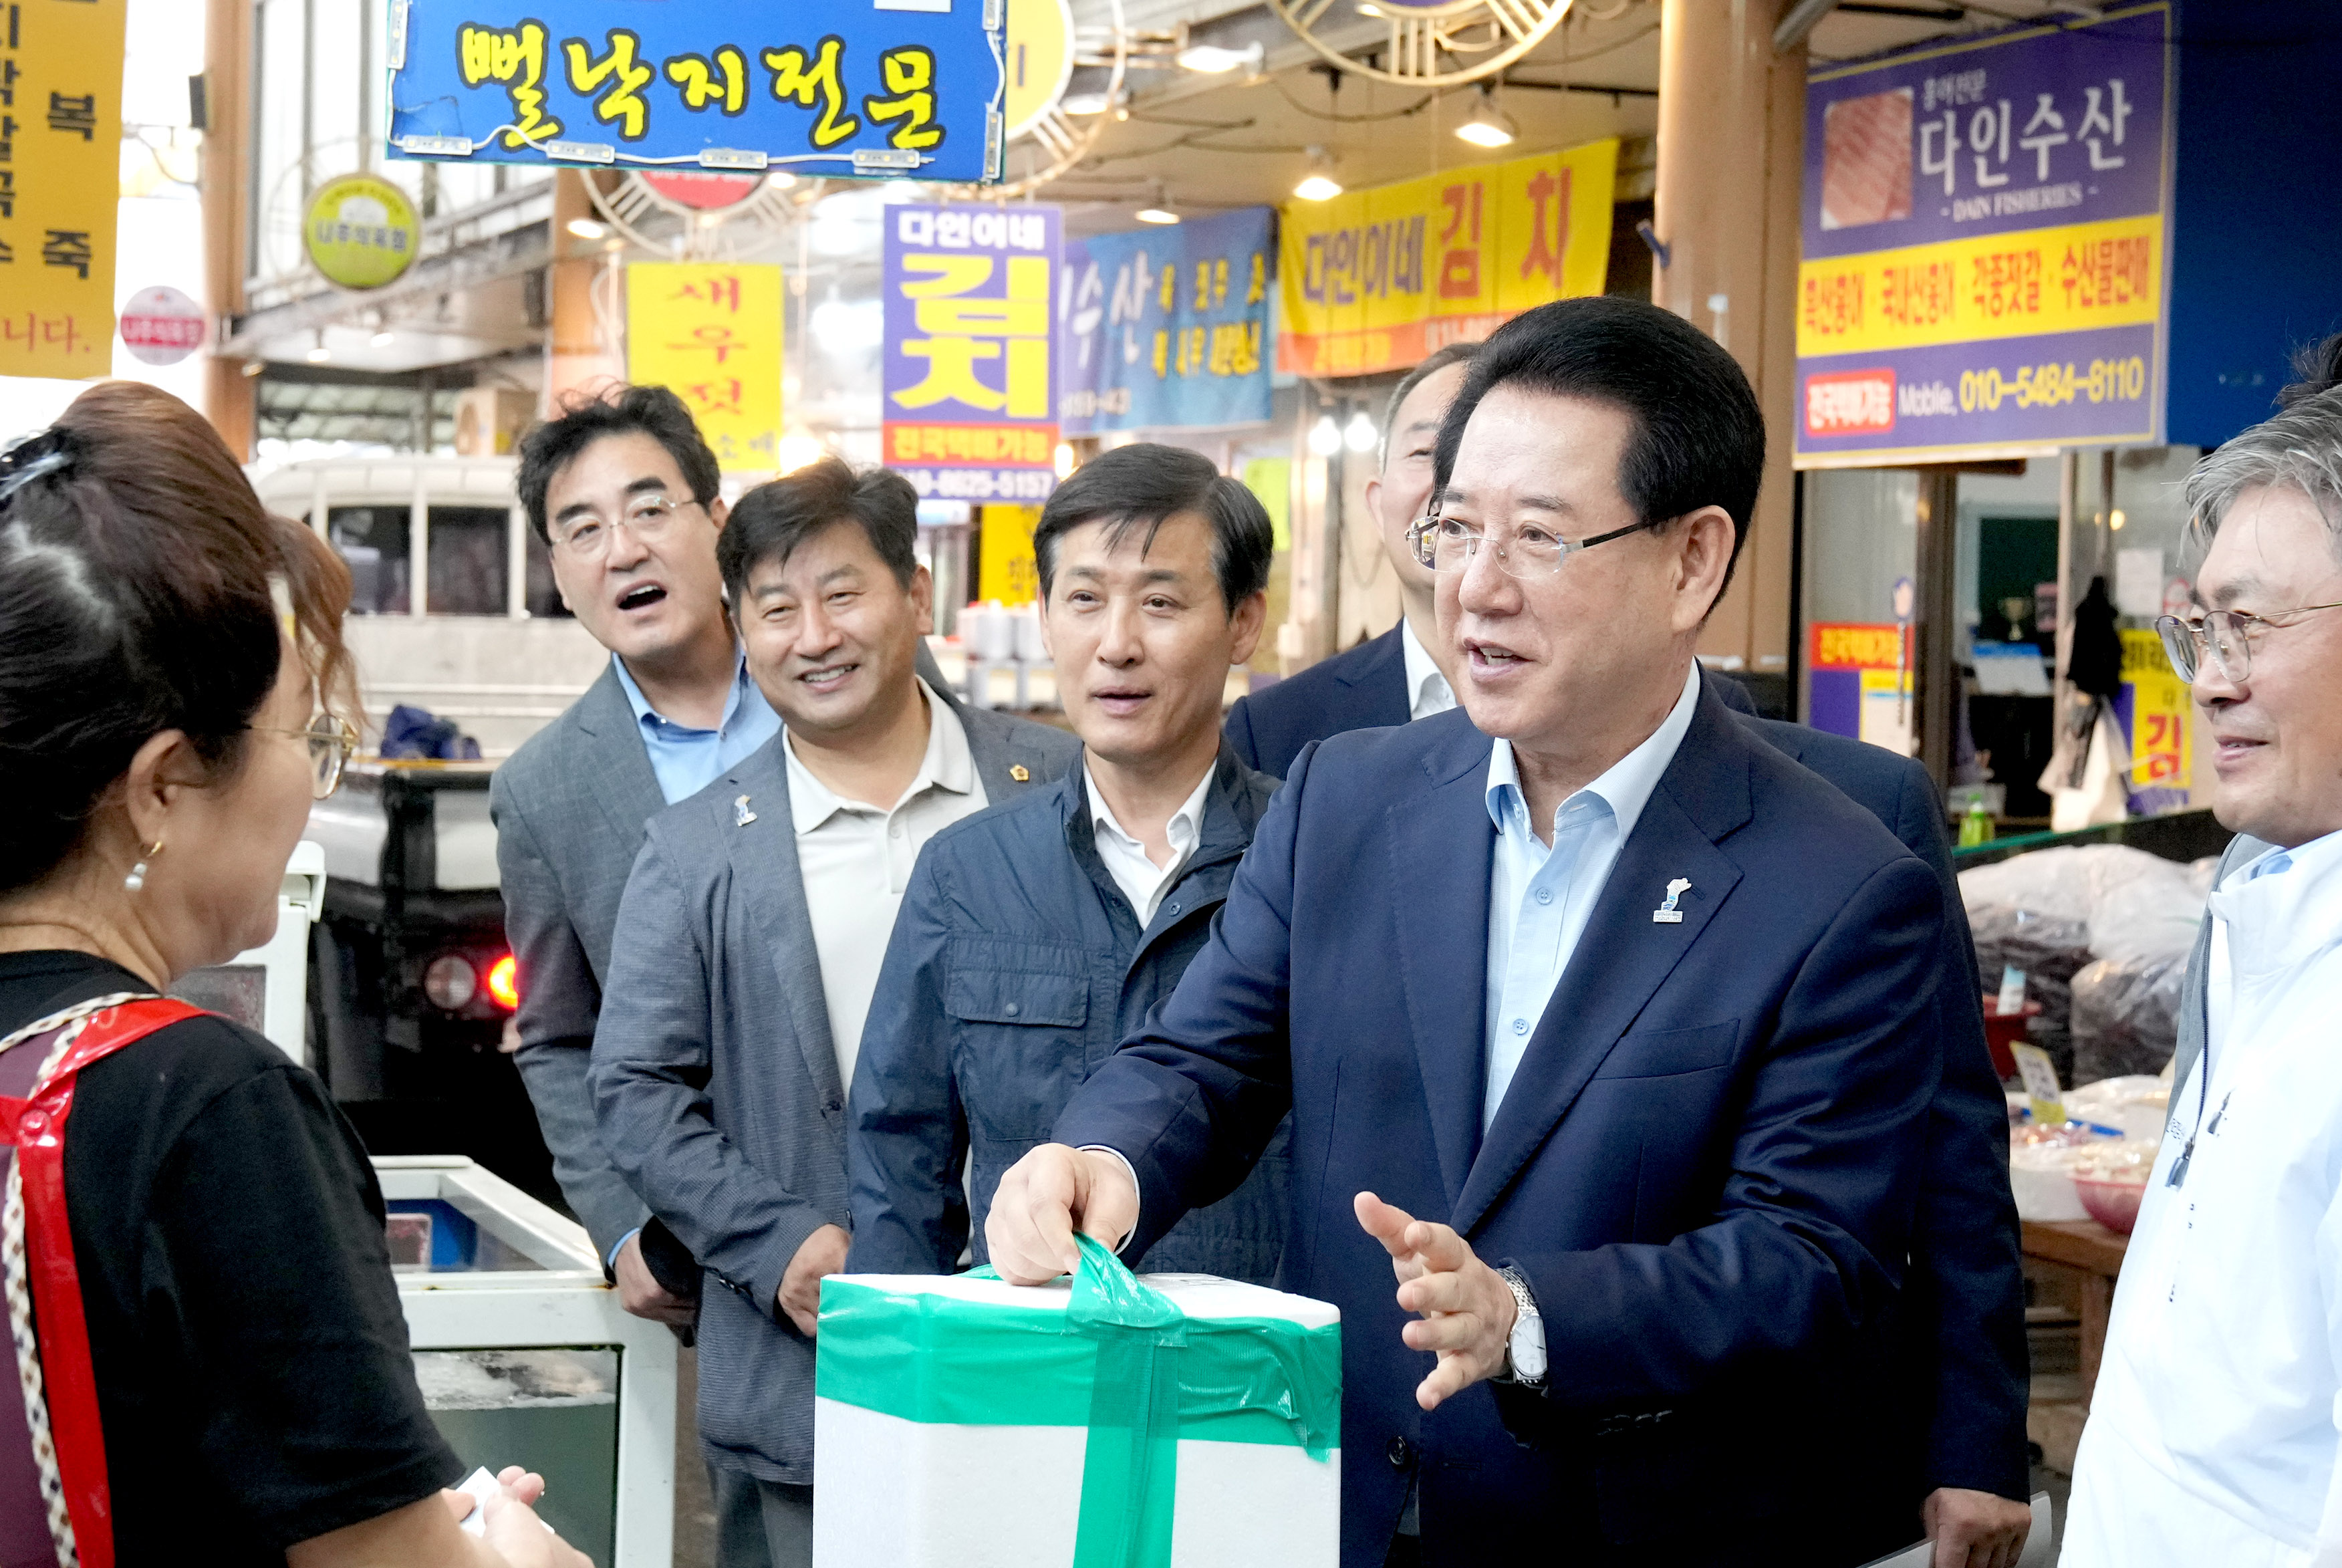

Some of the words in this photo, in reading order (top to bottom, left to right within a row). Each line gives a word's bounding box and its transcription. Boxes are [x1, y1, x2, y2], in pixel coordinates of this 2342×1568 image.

[459, 20, 944, 149] 뻘낙지전문
[1920, 79, 2132, 197] 다인수산
[898, 211, 1047, 250] 다인이네
[1304, 215, 1426, 306] 다인이네
[1438, 166, 1572, 300] 김치
[890, 253, 1050, 419] 김치
[1058, 250, 1154, 370] 수산
[1960, 356, 2145, 412] 010-5484-8110
